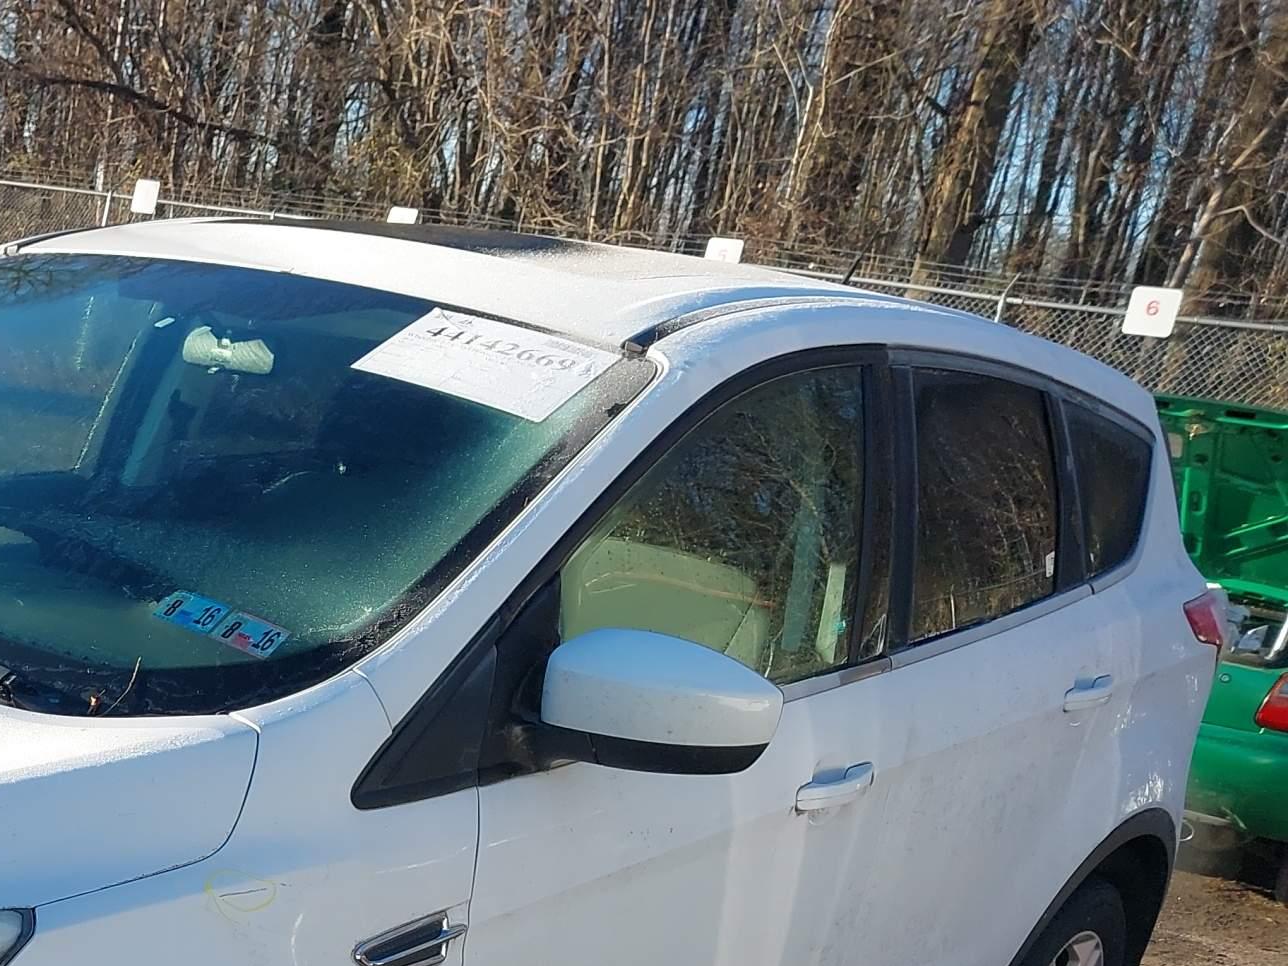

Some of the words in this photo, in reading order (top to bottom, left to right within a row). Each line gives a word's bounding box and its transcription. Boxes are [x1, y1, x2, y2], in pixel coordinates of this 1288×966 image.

[1146, 300, 1160, 316] 6
[425, 325, 577, 372] 44142669
[193, 605, 222, 627] 16
[252, 629, 281, 651] 16
